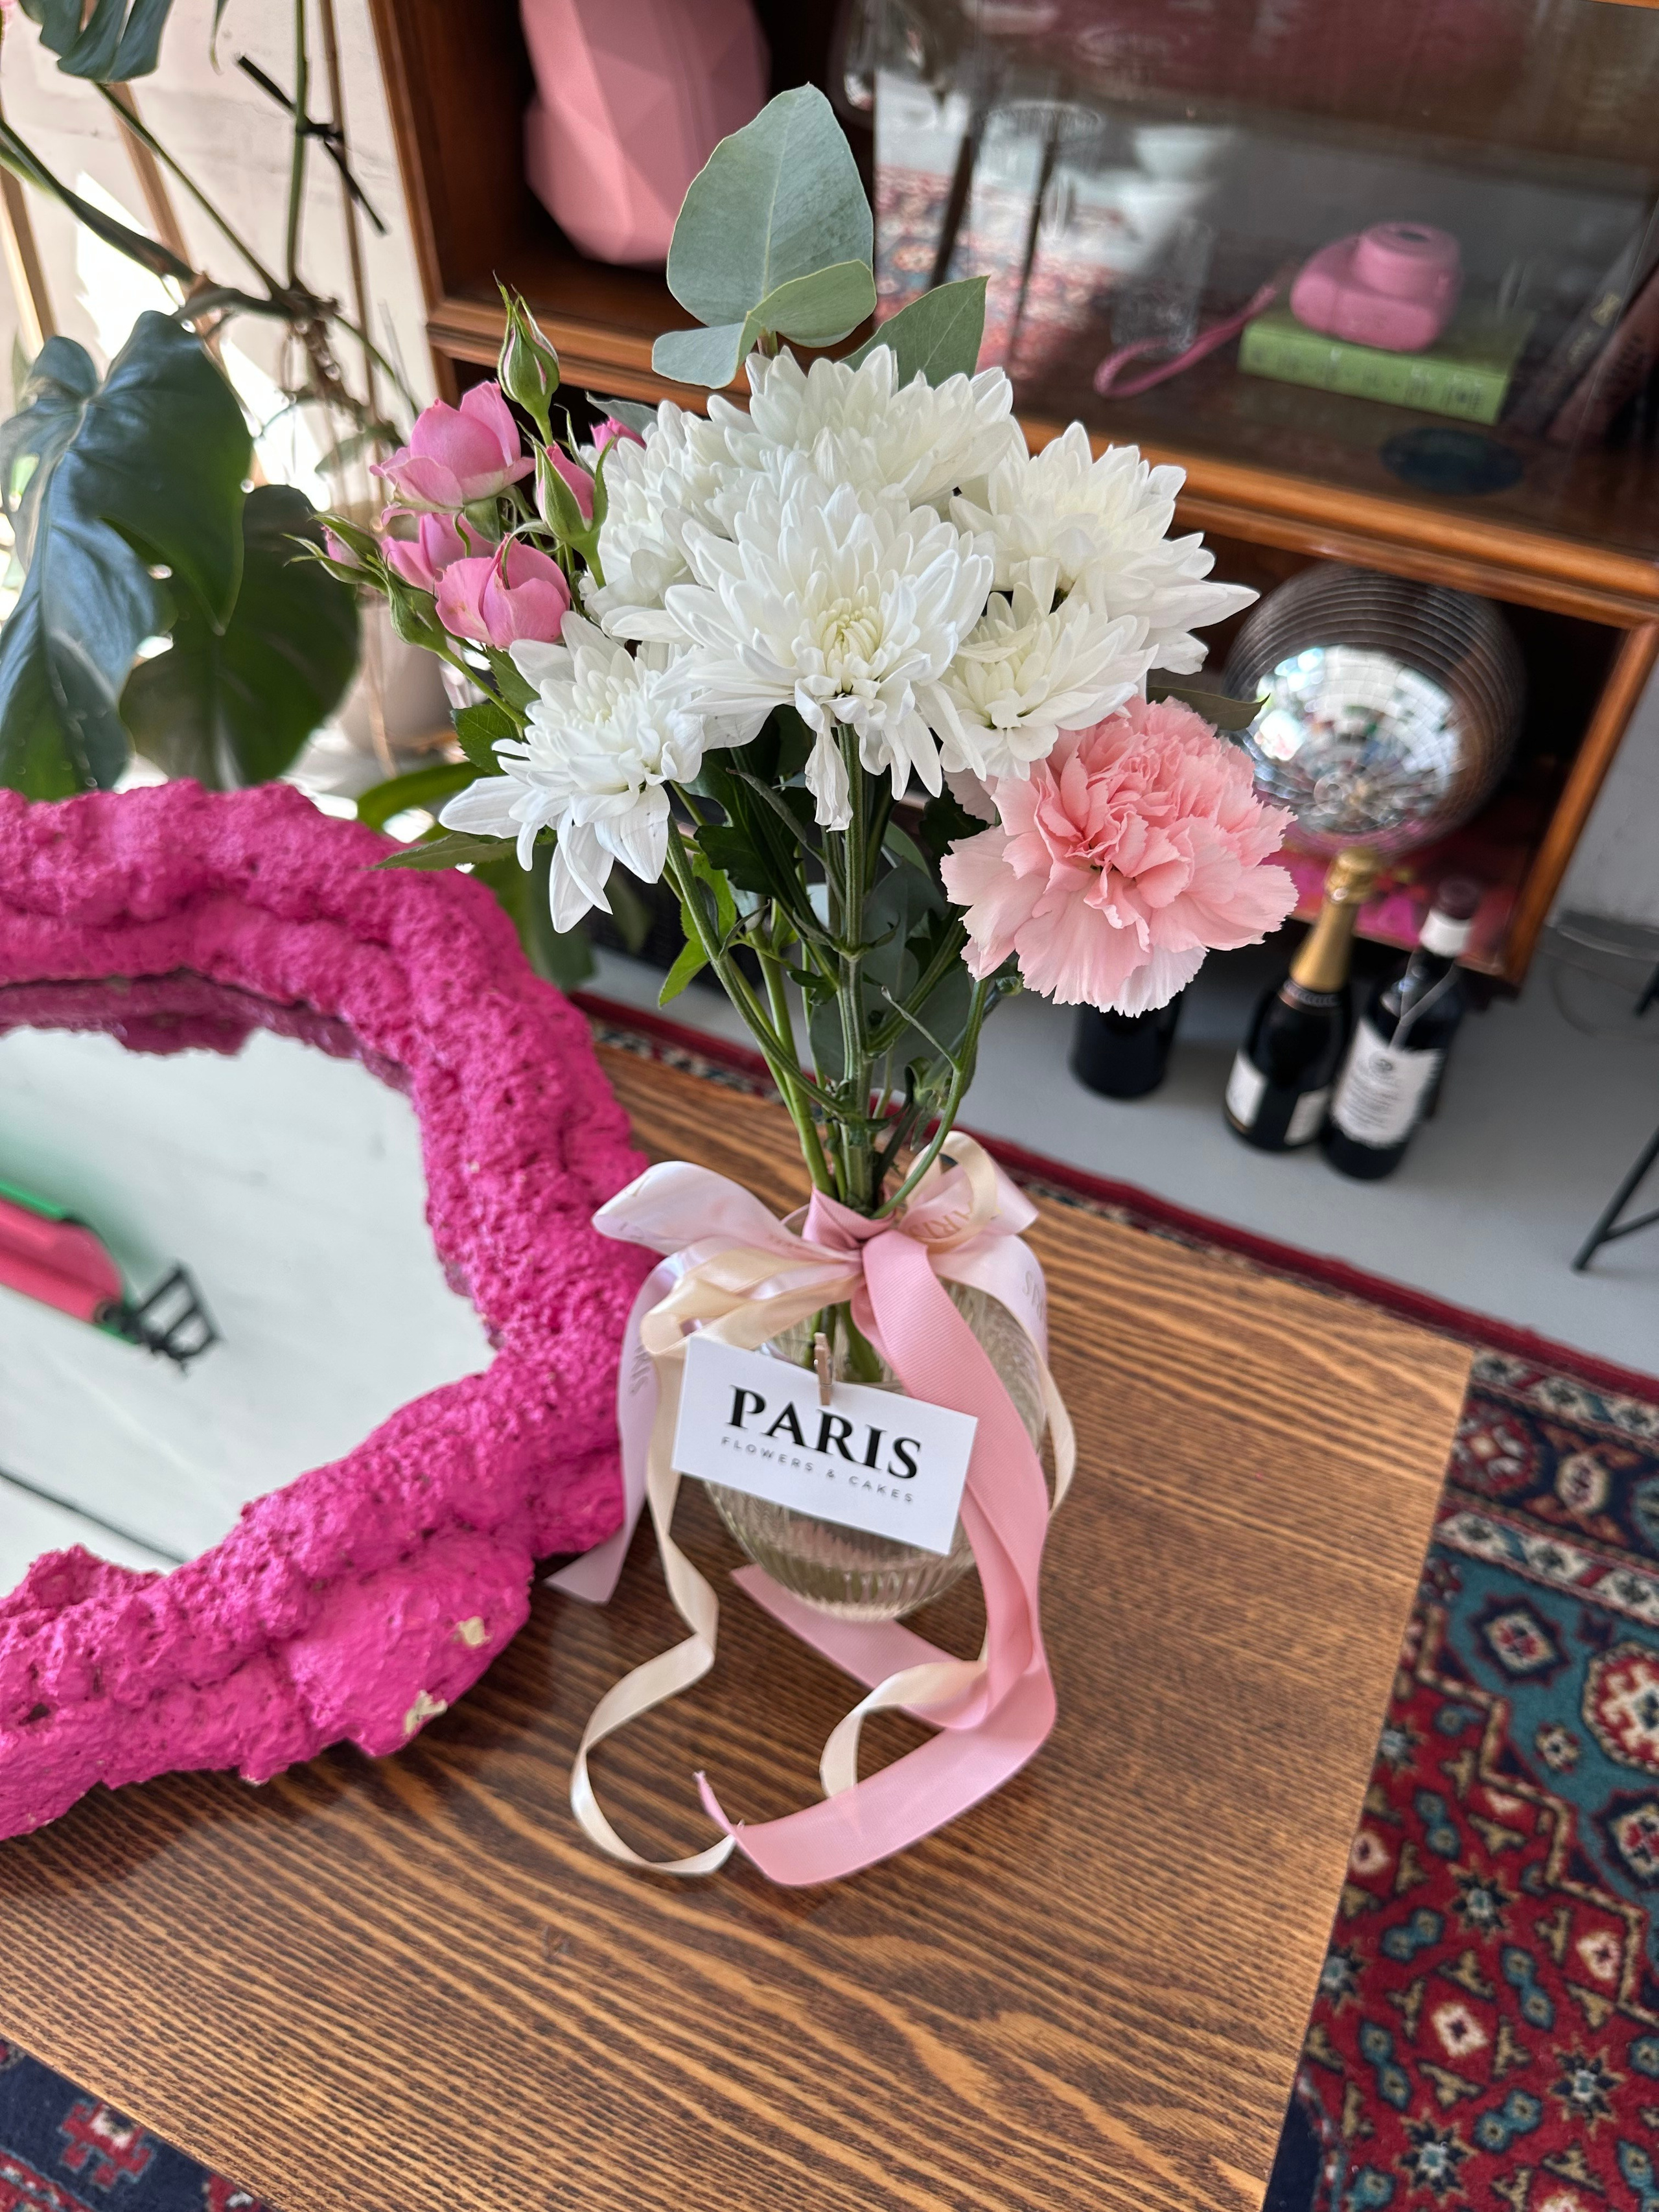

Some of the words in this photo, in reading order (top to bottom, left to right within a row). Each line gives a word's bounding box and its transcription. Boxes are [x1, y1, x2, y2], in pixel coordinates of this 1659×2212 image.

[721, 1437, 813, 1471] FLOWERS
[826, 1469, 837, 1479] &
[848, 1475, 914, 1503] CAKES
[725, 1385, 921, 1478] PARIS
